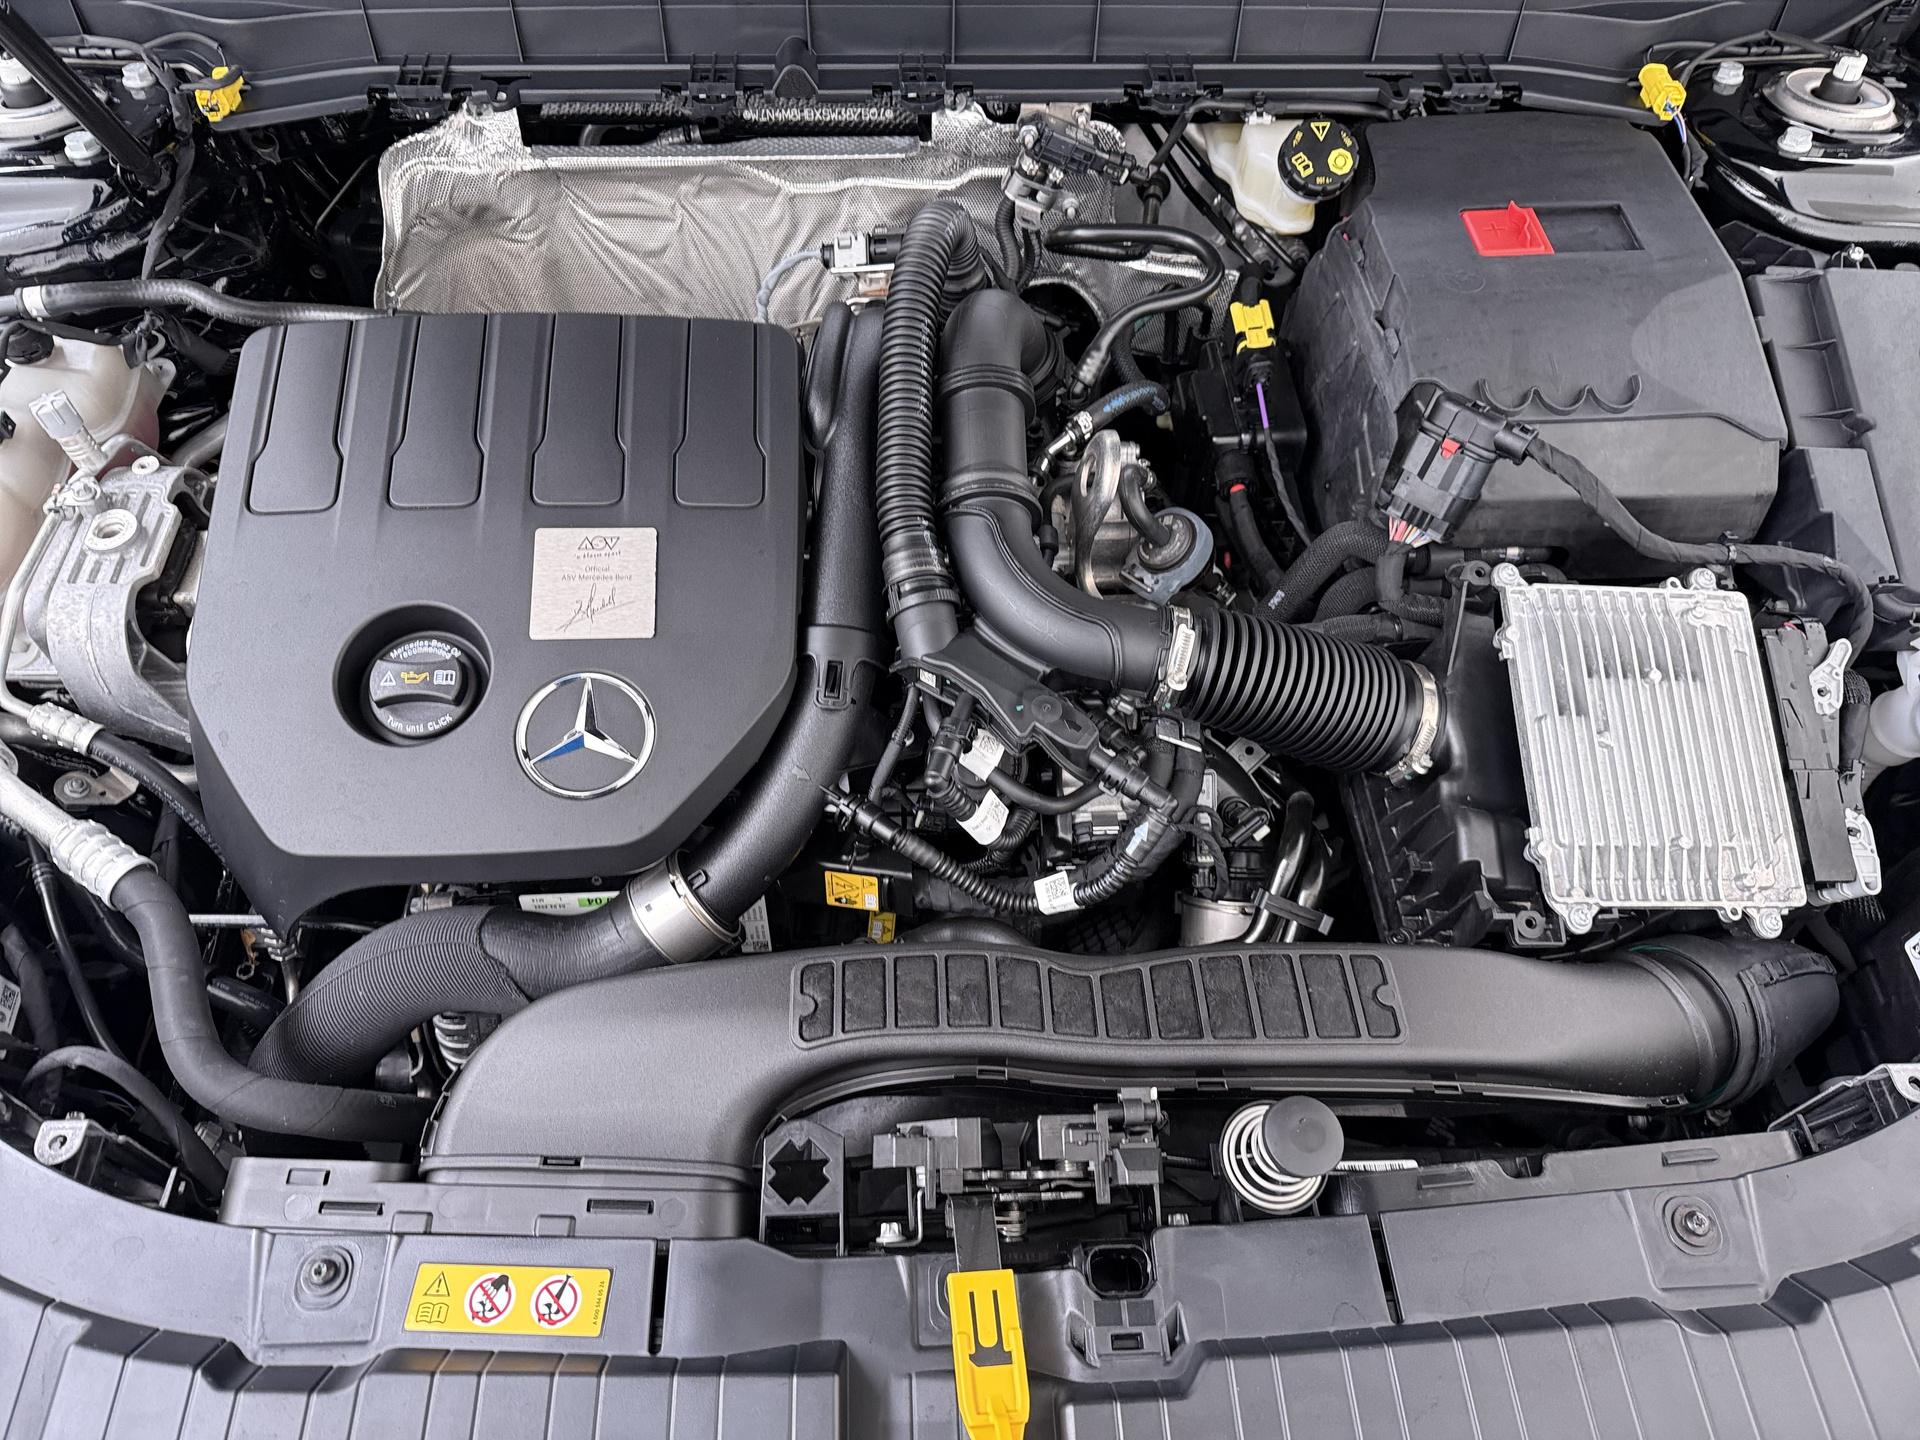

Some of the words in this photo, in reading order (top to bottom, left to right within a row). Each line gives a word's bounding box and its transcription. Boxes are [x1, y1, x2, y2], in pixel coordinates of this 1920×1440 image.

[584, 564, 610, 574] Official
[561, 573, 577, 582] ASV
[578, 573, 613, 582] Mercedes
[615, 572, 632, 582] Benz
[387, 714, 403, 731] Turn
[427, 712, 453, 731] CLICK
